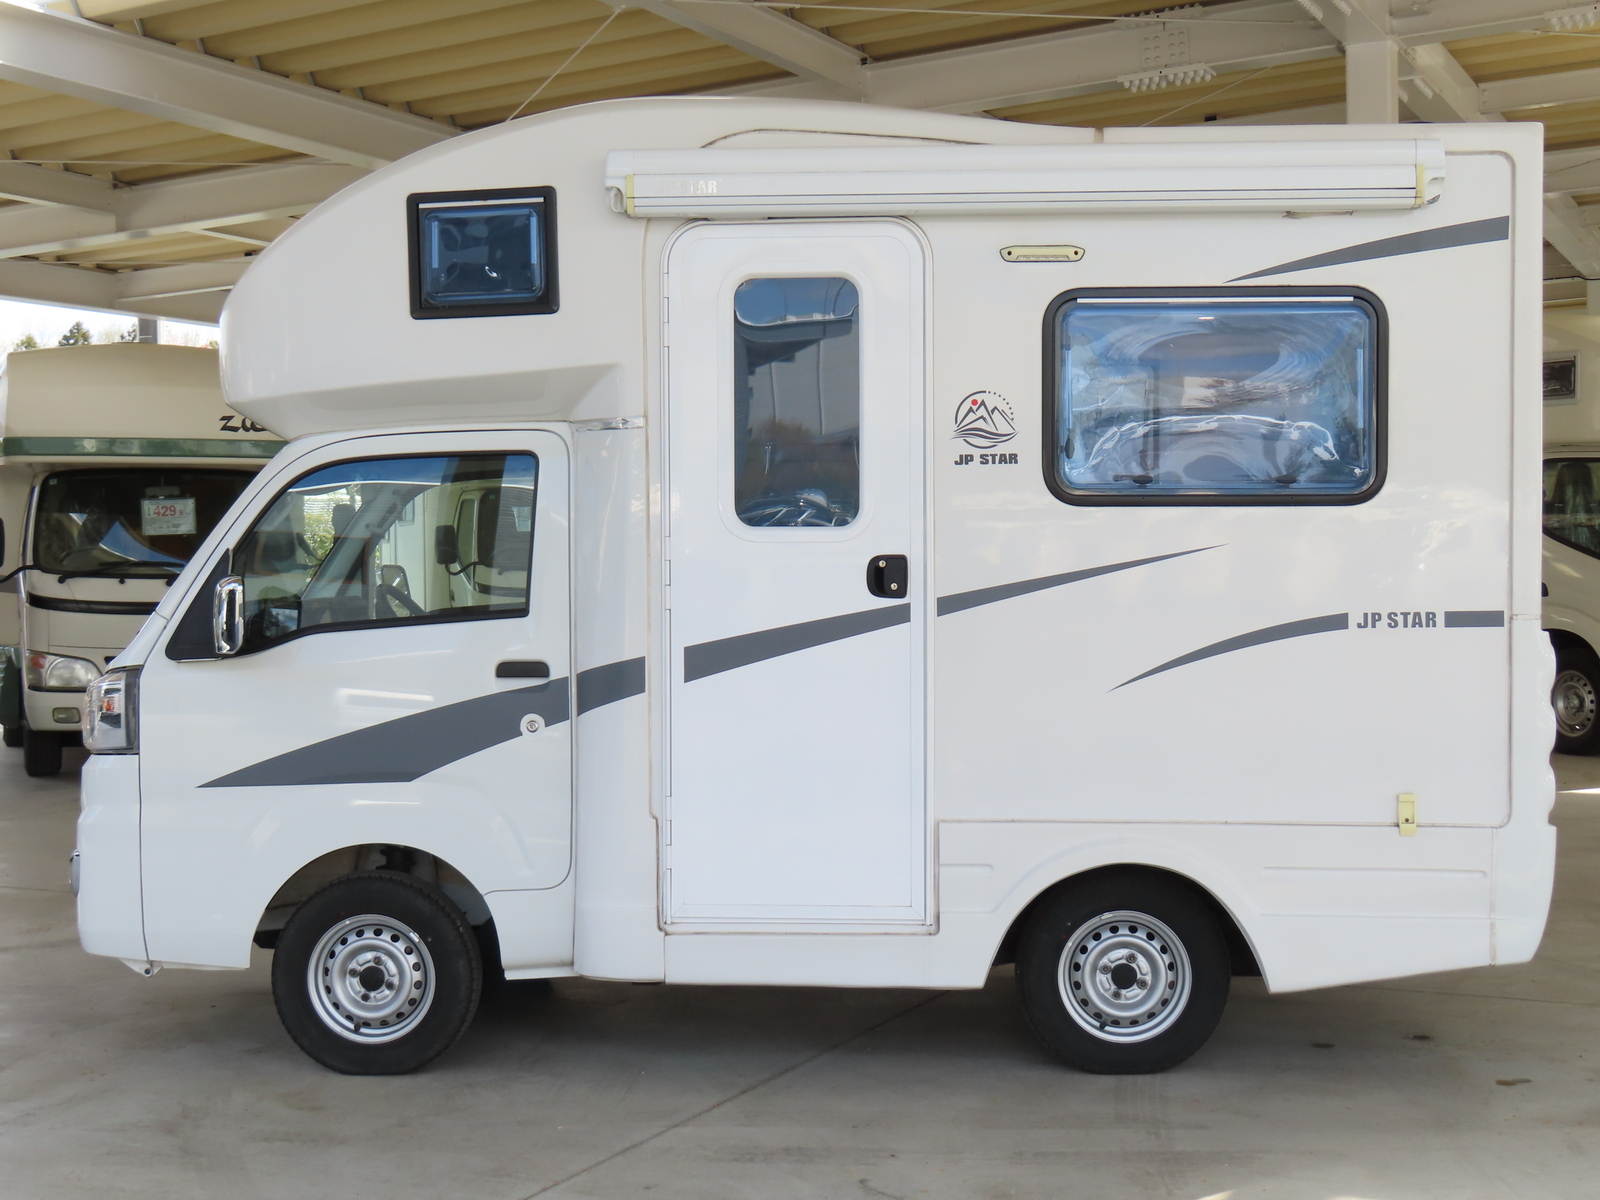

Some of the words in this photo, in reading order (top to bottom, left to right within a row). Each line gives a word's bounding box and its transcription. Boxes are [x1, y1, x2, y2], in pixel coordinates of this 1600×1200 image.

[954, 454, 974, 465] JP
[979, 453, 1018, 464] STAR
[1356, 612, 1382, 629] JP
[1387, 611, 1437, 629] STAR
